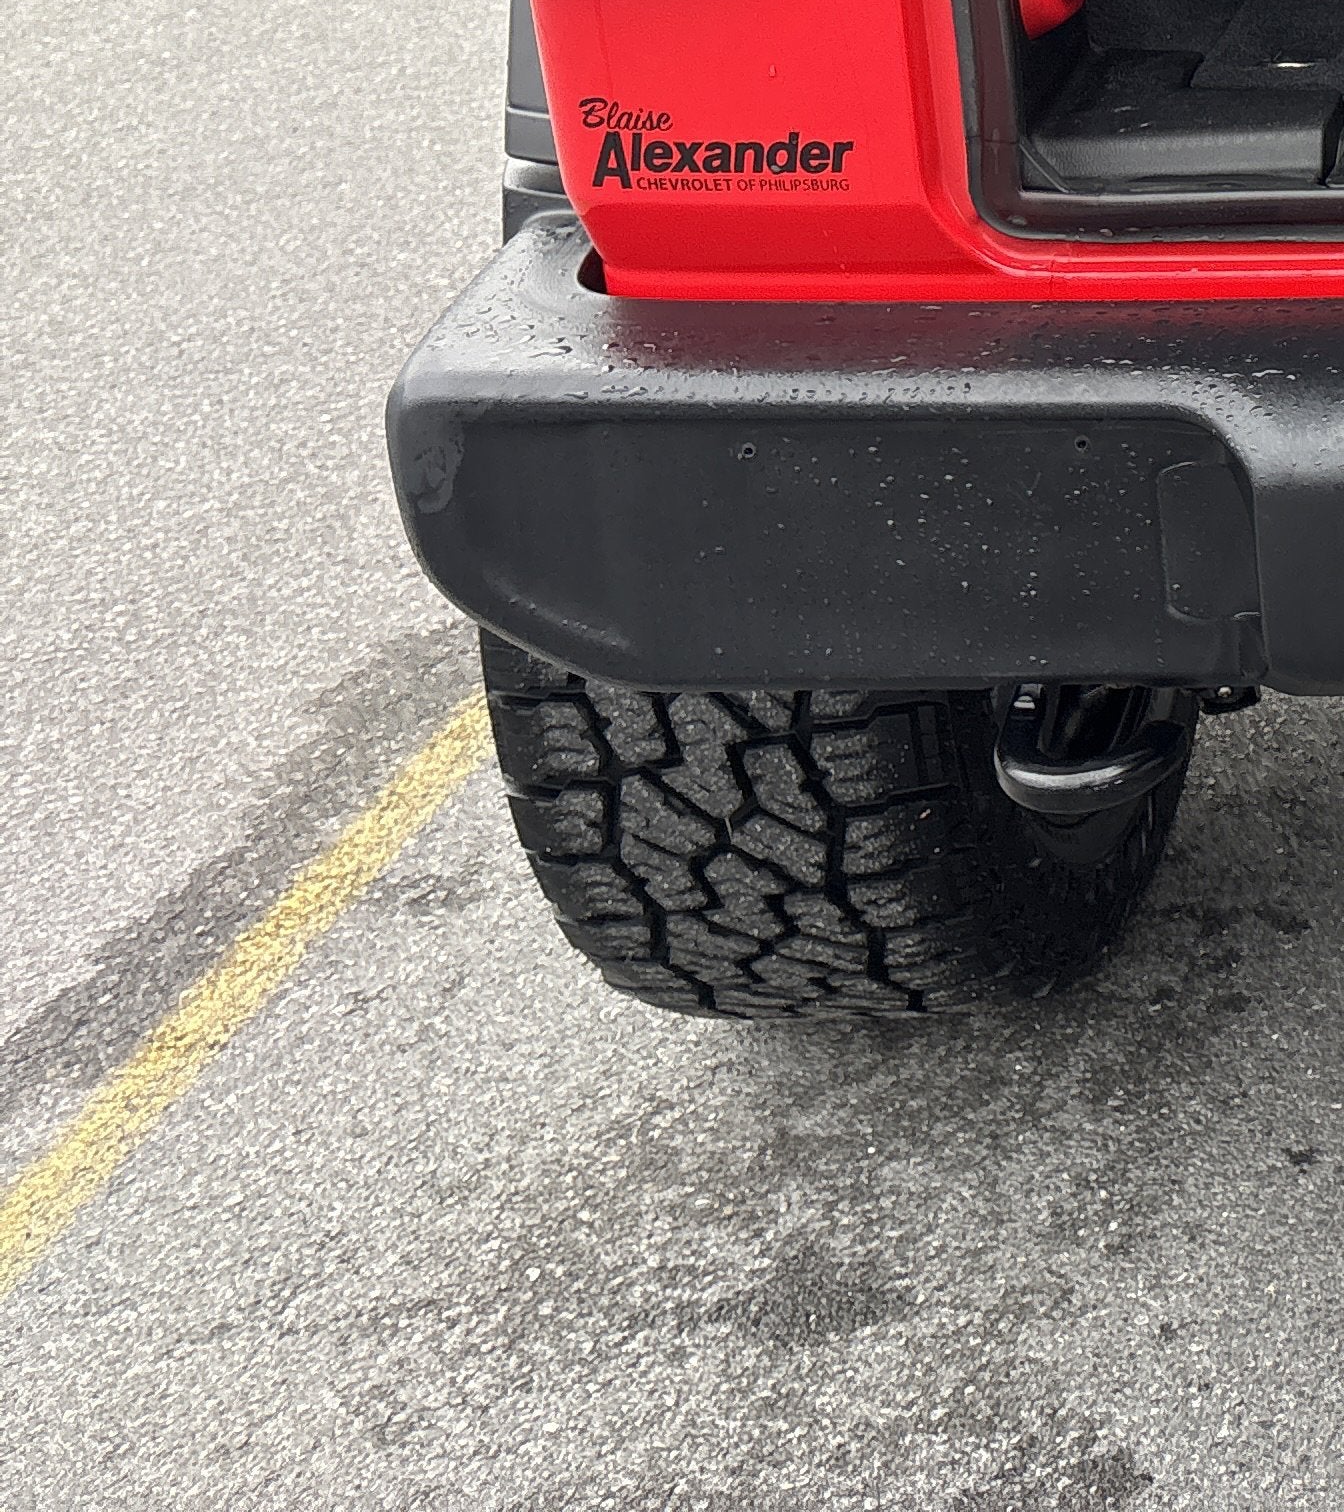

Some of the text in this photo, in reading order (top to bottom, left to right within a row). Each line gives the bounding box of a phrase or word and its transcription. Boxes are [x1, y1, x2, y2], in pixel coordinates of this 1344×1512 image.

[578, 97, 674, 131] Blaise
[591, 130, 855, 189] Alexander
[636, 176, 851, 192] CHEVROLET OF PHILIPSBURG
